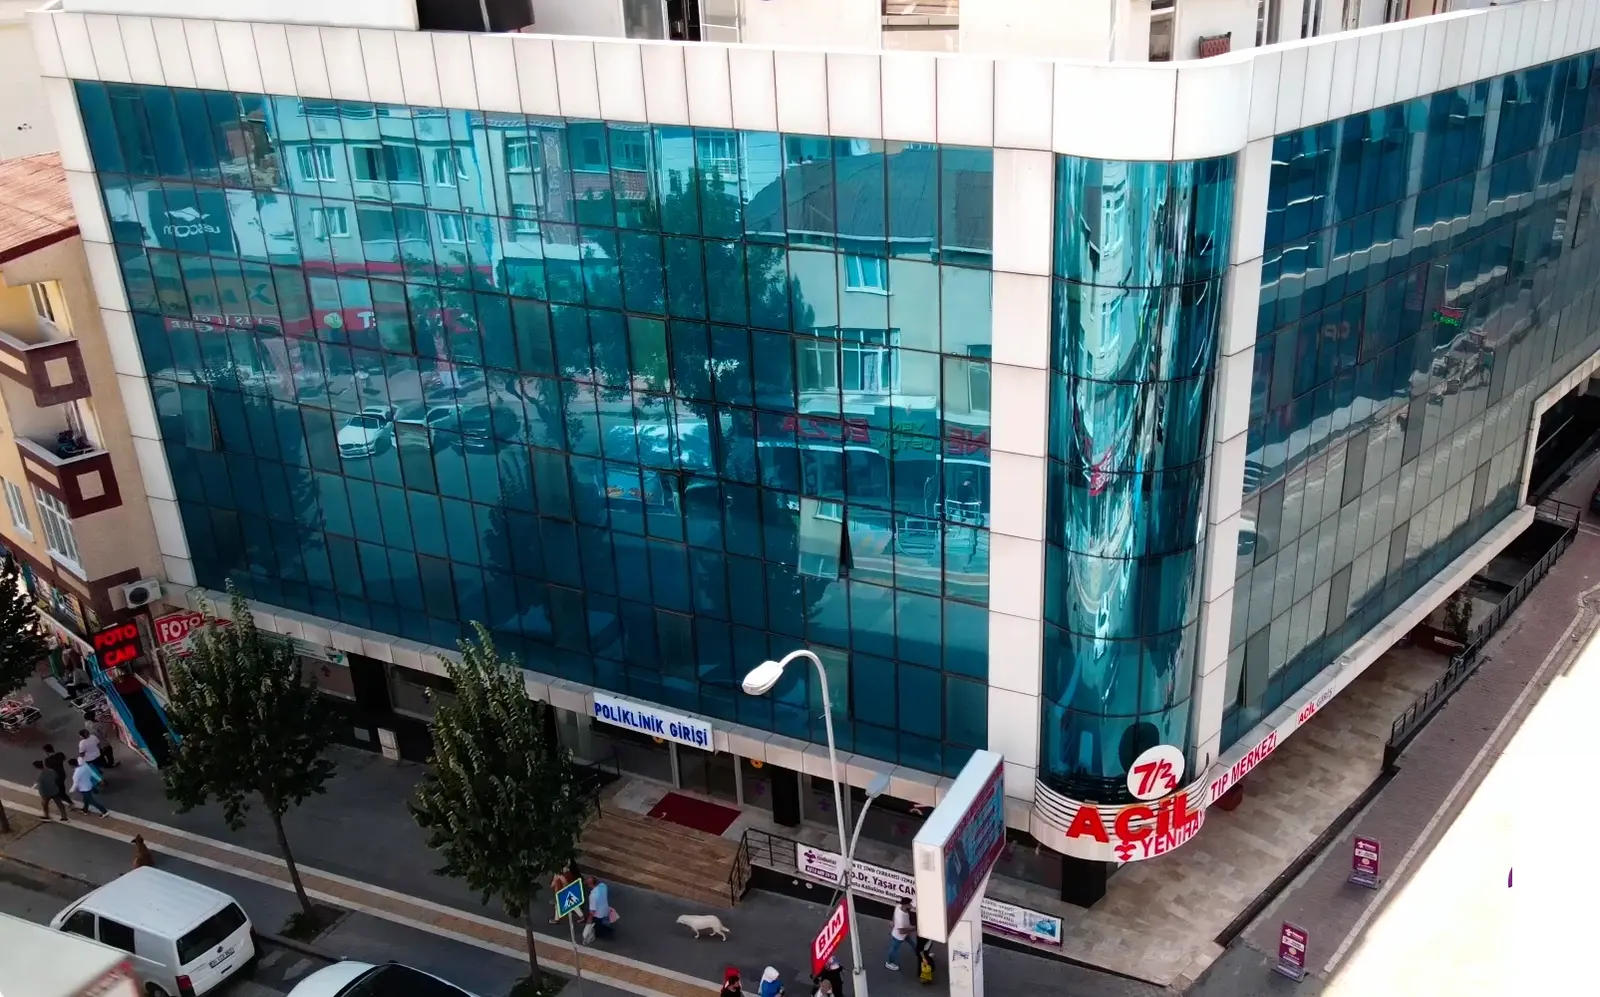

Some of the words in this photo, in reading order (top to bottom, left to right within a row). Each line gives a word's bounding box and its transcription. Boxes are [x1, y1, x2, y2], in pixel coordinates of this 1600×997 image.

[94, 623, 137, 649] FOTO
[160, 615, 201, 642] FOTO
[594, 702, 664, 734] POLİKLİNİK
[670, 721, 708, 747] GİRİŞİ
[1211, 773, 1228, 801] TIP
[1231, 730, 1277, 785] MERKEZİ
[872, 876, 897, 891] Yaşar
